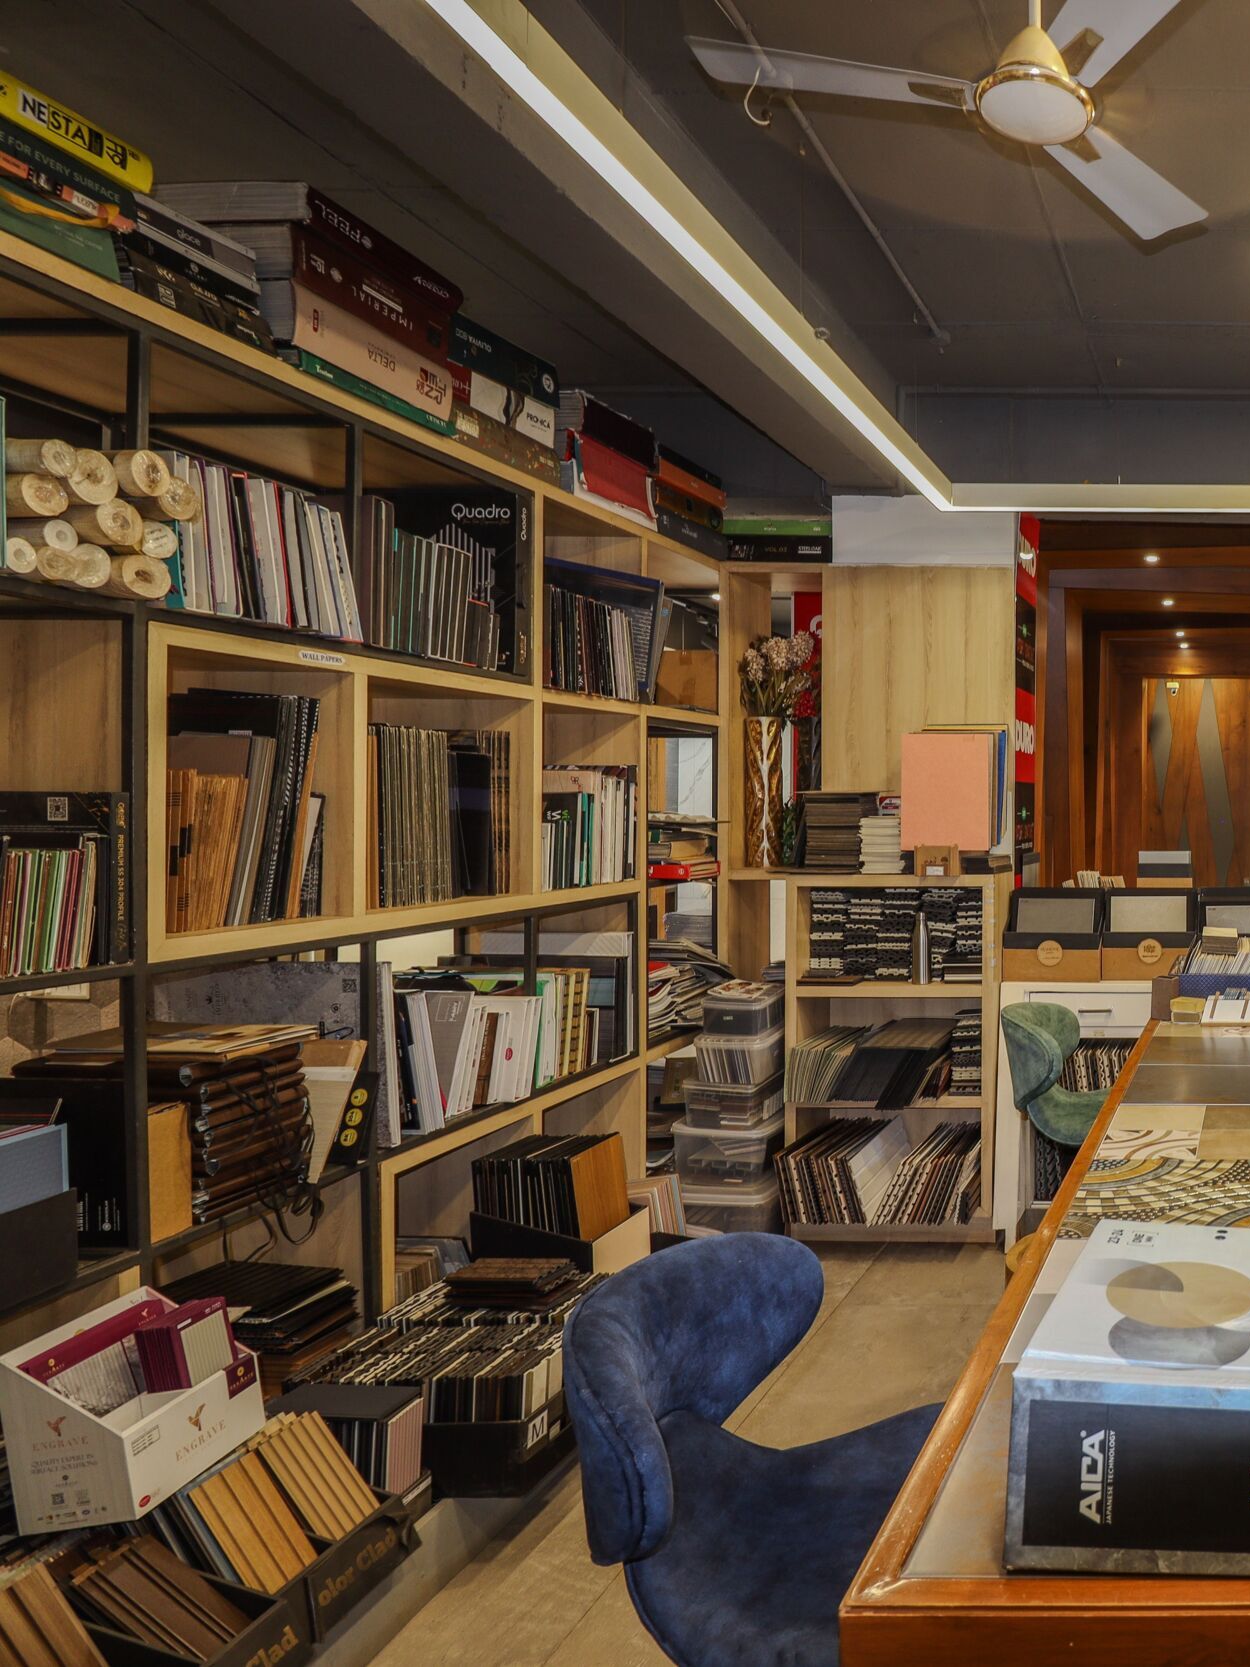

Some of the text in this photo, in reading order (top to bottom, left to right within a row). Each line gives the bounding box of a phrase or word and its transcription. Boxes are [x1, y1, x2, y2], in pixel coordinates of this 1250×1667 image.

[7, 136, 31, 156] FOR
[34, 151, 70, 177] EVERY
[72, 172, 120, 202] SURFACE
[352, 286, 413, 331] IMPERIAL
[367, 348, 396, 373] DELTA
[451, 503, 511, 521] Quadro
[302, 652, 343, 664] WALL PAPERS
[1016, 719, 1035, 755] DURO
[117, 834, 125, 865] PREMIUM
[117, 892, 125, 921] PROFILE
[32, 1436, 90, 1451] ENGRAVE
[176, 1420, 226, 1462] ENGRAVE
[531, 1415, 544, 1442] M
[1079, 1429, 1106, 1524] AICA
[1105, 1430, 1117, 1525] JAPANESE TECHNOLOGY
[318, 1527, 397, 1607] olor Clad
